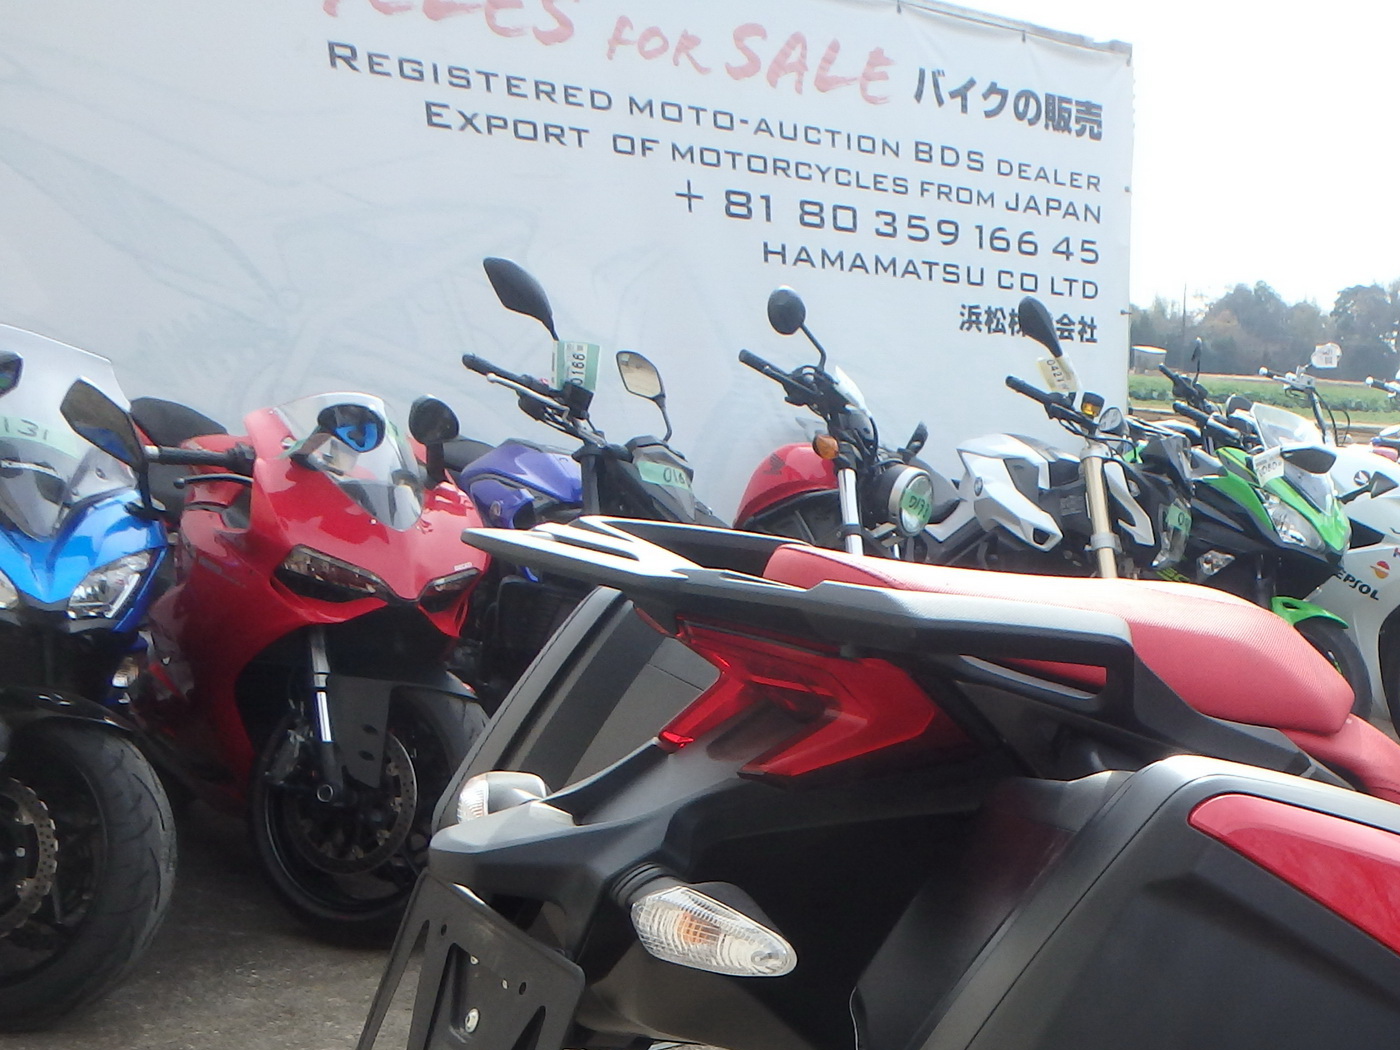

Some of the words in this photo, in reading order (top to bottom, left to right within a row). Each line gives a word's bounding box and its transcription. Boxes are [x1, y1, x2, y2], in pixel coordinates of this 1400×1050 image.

[607, 15, 711, 75] FOR
[725, 23, 895, 105] SALE
[327, 40, 612, 111] REGISTERED
[629, 96, 900, 158] MOTO-AUCTION
[914, 140, 985, 172] BDS
[997, 158, 1101, 193] DEALER
[914, 67, 1103, 141] バイクの販売
[425, 100, 590, 148] EXPORT
[613, 134, 659, 157] OF
[671, 142, 909, 195] MOTORCYCLES
[920, 181, 995, 208] FROM
[1005, 192, 1101, 225] JAPAN
[725, 190, 772, 222] 81
[799, 200, 858, 233] 80
[875, 210, 959, 246] 359
[975, 225, 1039, 256] 166
[1052, 236, 1100, 265] 45
[763, 241, 984, 287] HAMAMATSU
[998, 271, 1038, 293] CO
[1050, 275, 1099, 300] LTD
[960, 303, 1098, 343] 浜松会社
[1336, 568, 1380, 601] EPSOL
